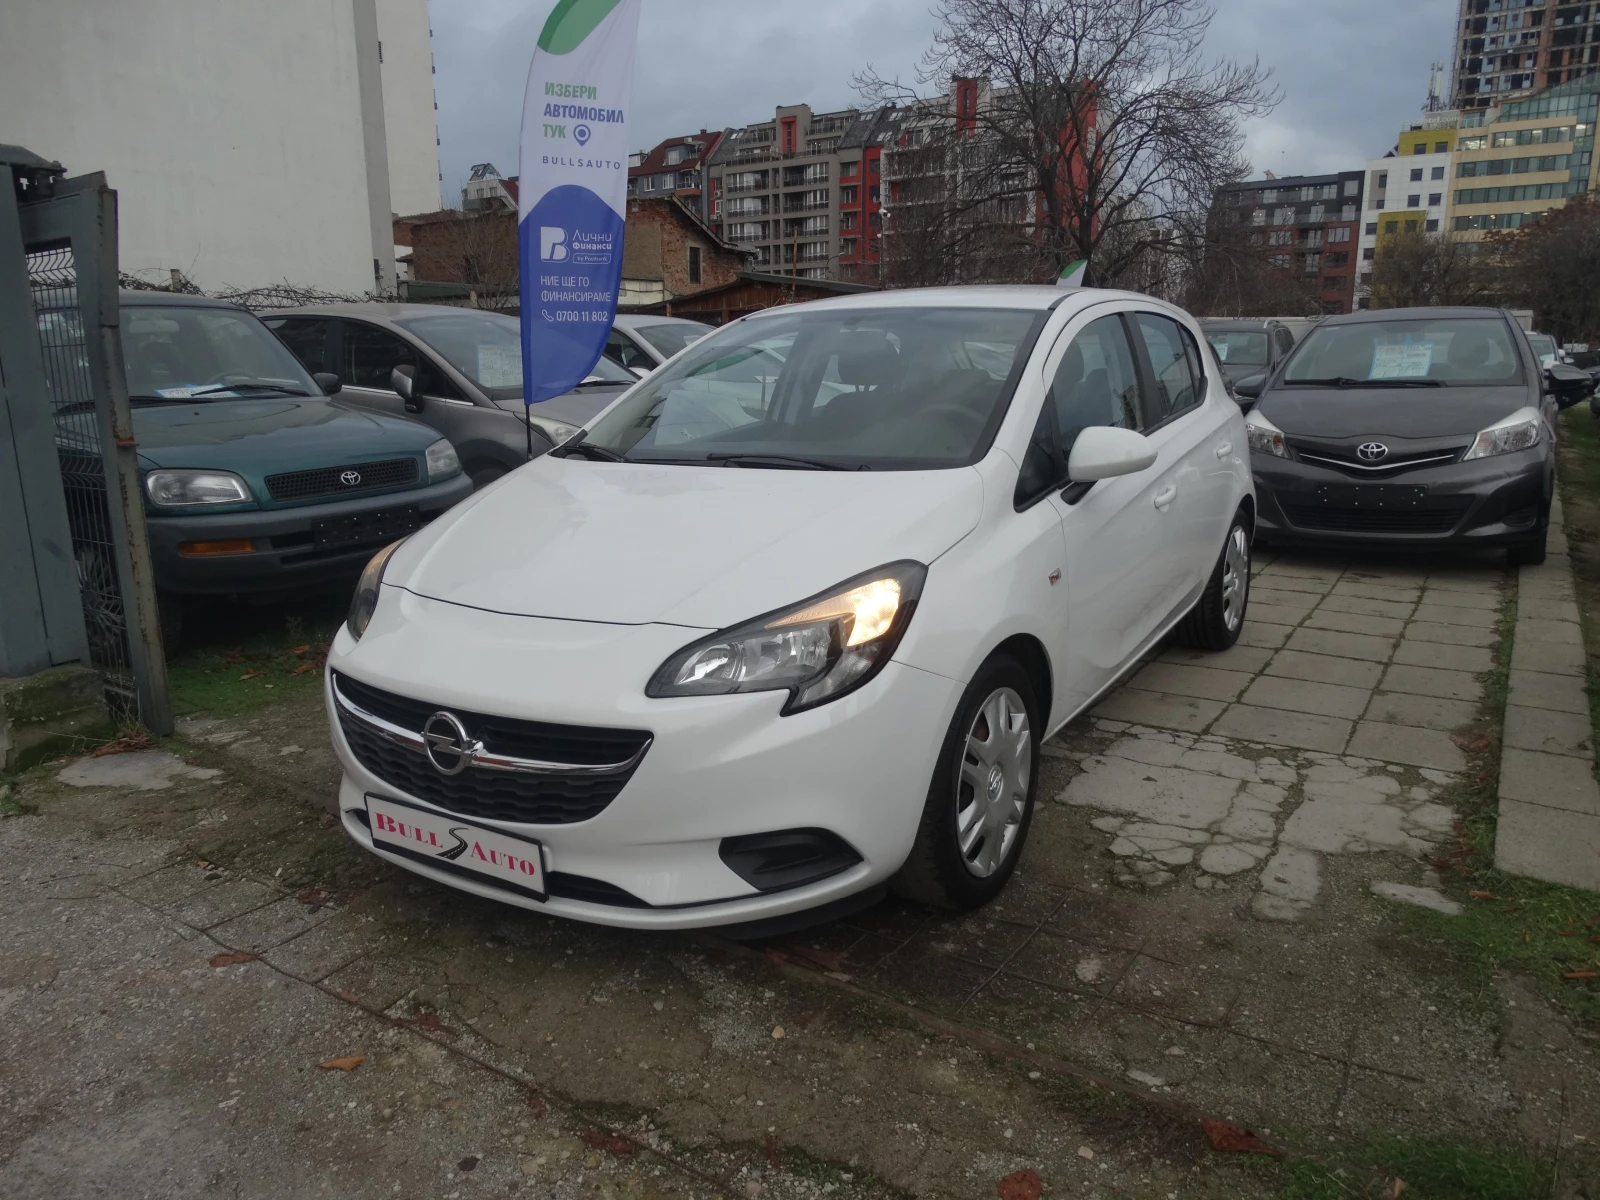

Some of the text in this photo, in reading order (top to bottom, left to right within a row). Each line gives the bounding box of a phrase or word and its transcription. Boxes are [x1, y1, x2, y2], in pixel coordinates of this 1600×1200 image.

[544, 82, 597, 100] ИЗБЕРИ
[543, 103, 625, 123] АВТОМОБИЛ
[542, 124, 567, 139] ТУК
[542, 155, 621, 170] BULLSAUTO
[572, 229, 612, 242] Лични
[572, 241, 612, 250] Финанси
[540, 275, 590, 287] НИЕ ЩЕ ГО
[541, 290, 611, 302] ФИНАНСИРАМЕ
[556, 310, 608, 322] 0700 11 802
[374, 811, 536, 876] BULL AUTO
